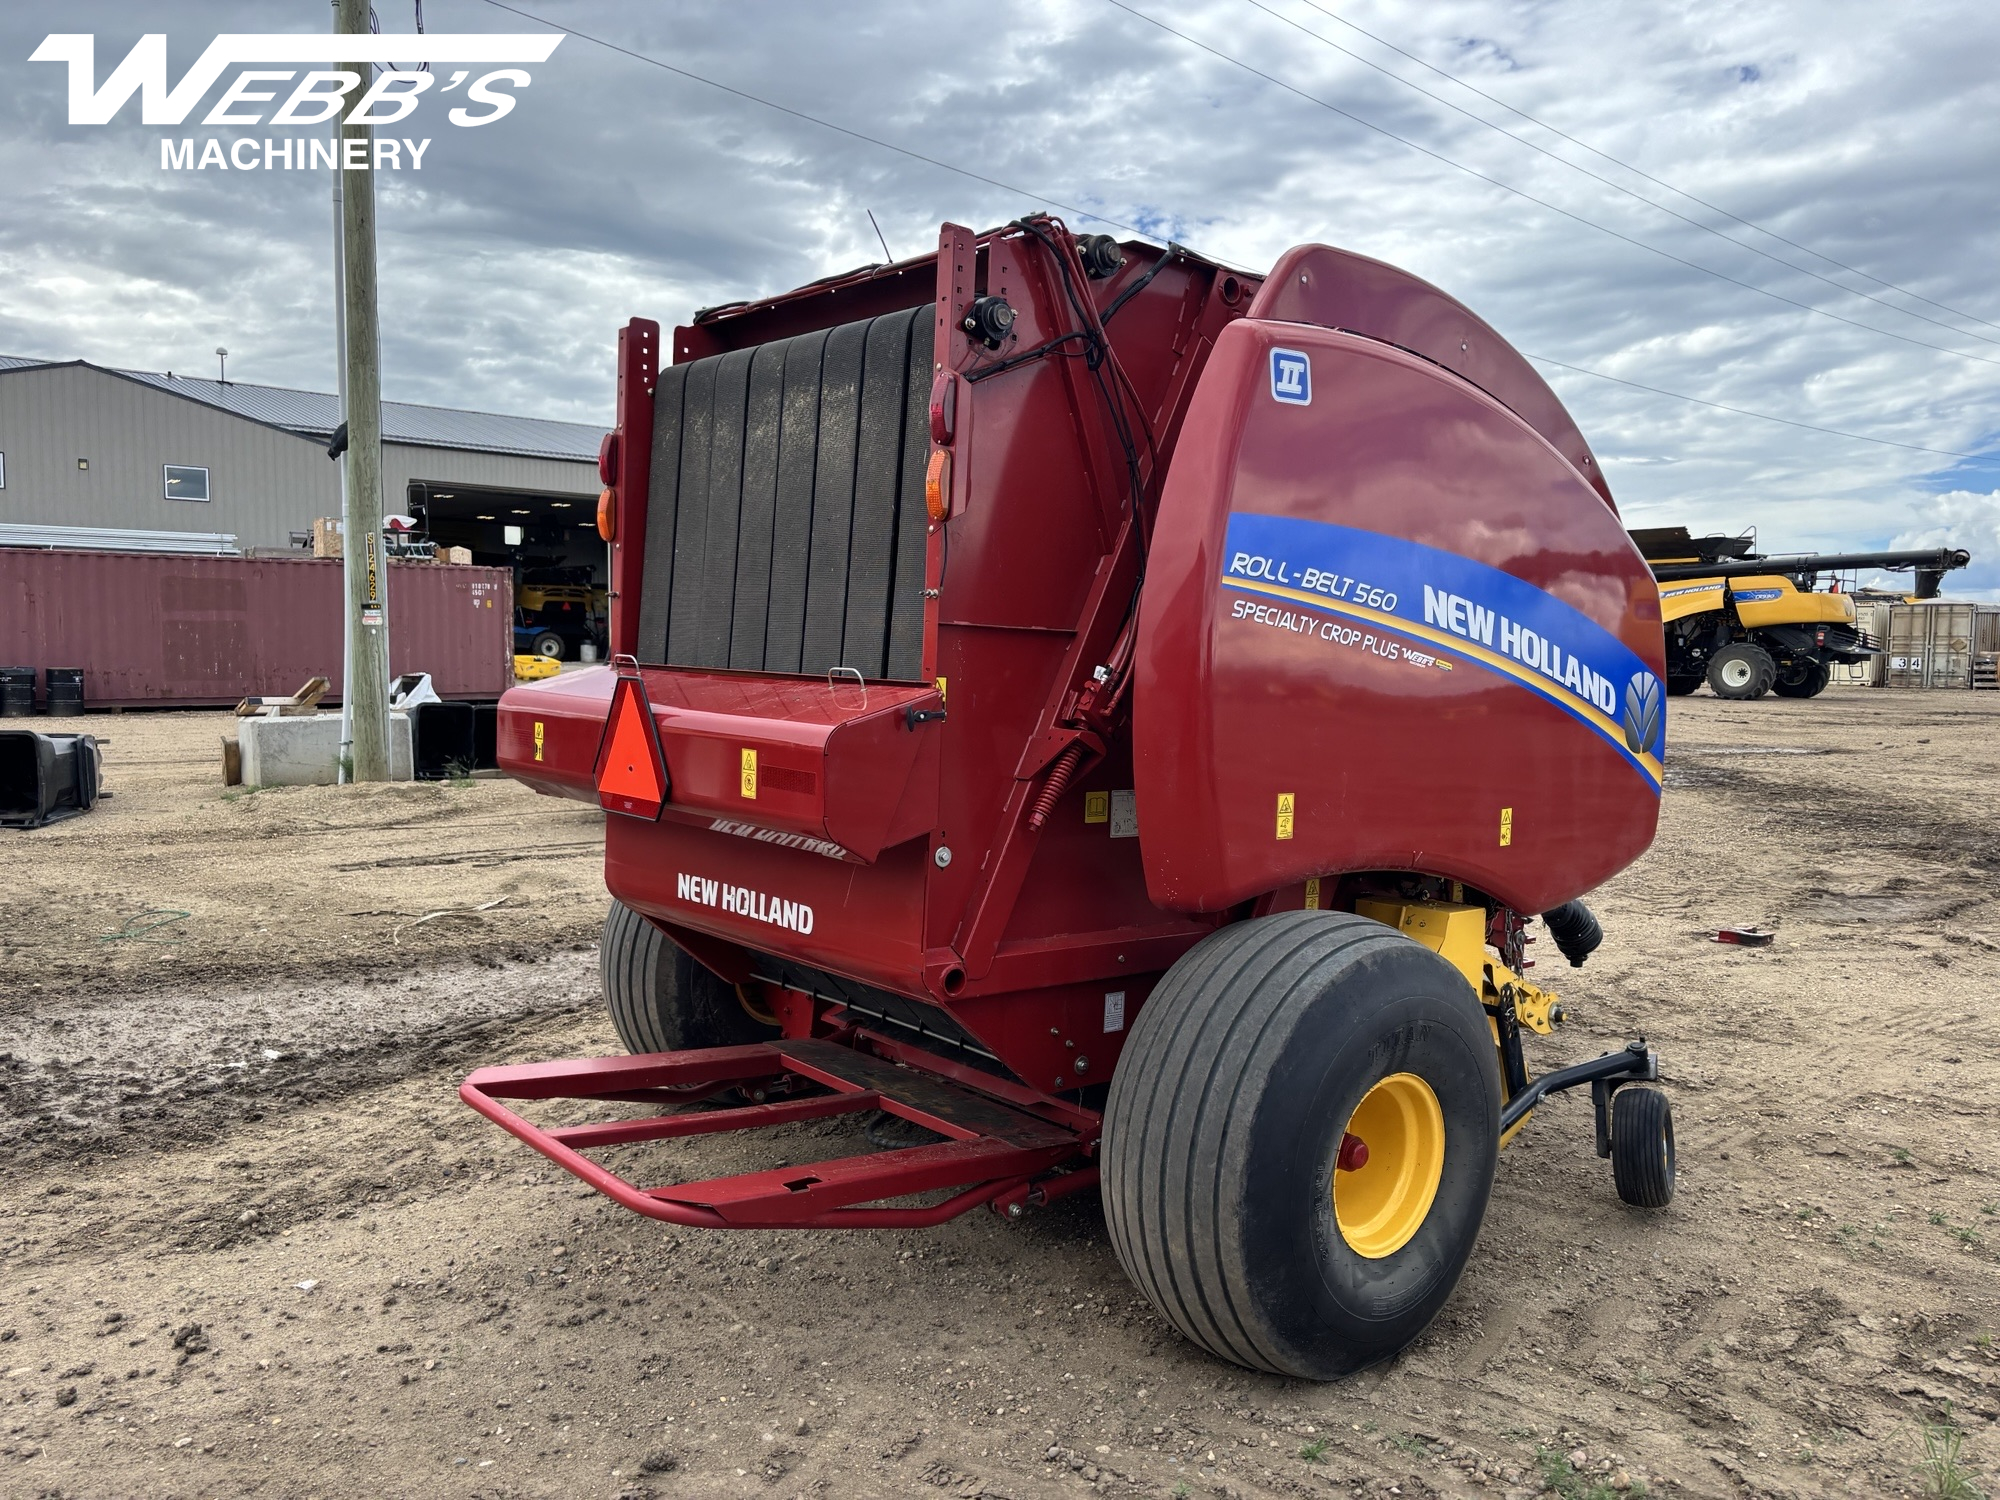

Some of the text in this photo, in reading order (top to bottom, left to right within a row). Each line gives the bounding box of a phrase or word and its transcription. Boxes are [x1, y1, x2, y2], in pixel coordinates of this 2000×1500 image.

[1229, 552, 1399, 612] ROLL-BELT 560
[1664, 584, 1722, 598] NEW HOLLAND
[1231, 599, 1401, 661] SPECIALTY CROP PLUS
[1423, 584, 1617, 716] NEW HOLLAND
[677, 872, 814, 936] NEW HOLLAND
